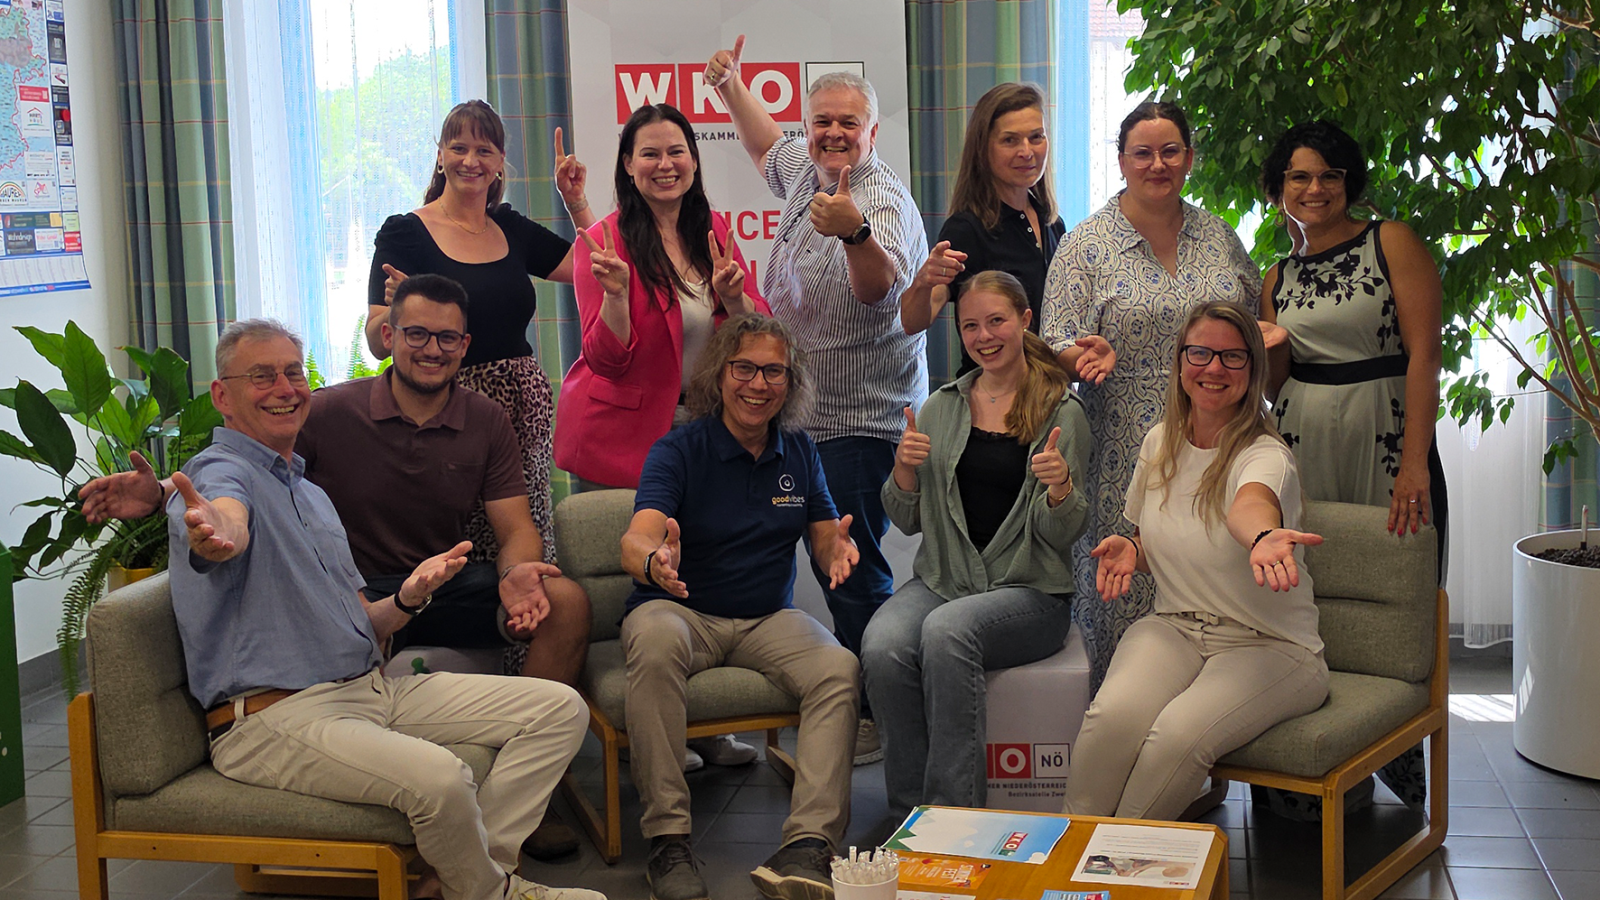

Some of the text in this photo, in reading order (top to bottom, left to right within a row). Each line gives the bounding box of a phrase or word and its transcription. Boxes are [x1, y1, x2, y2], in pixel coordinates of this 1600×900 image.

[619, 70, 794, 114] WKO
[718, 210, 781, 241] ICE
[999, 747, 1063, 774] O NÖ
[1002, 781, 1067, 789] NIEDERÖSTERREIC
